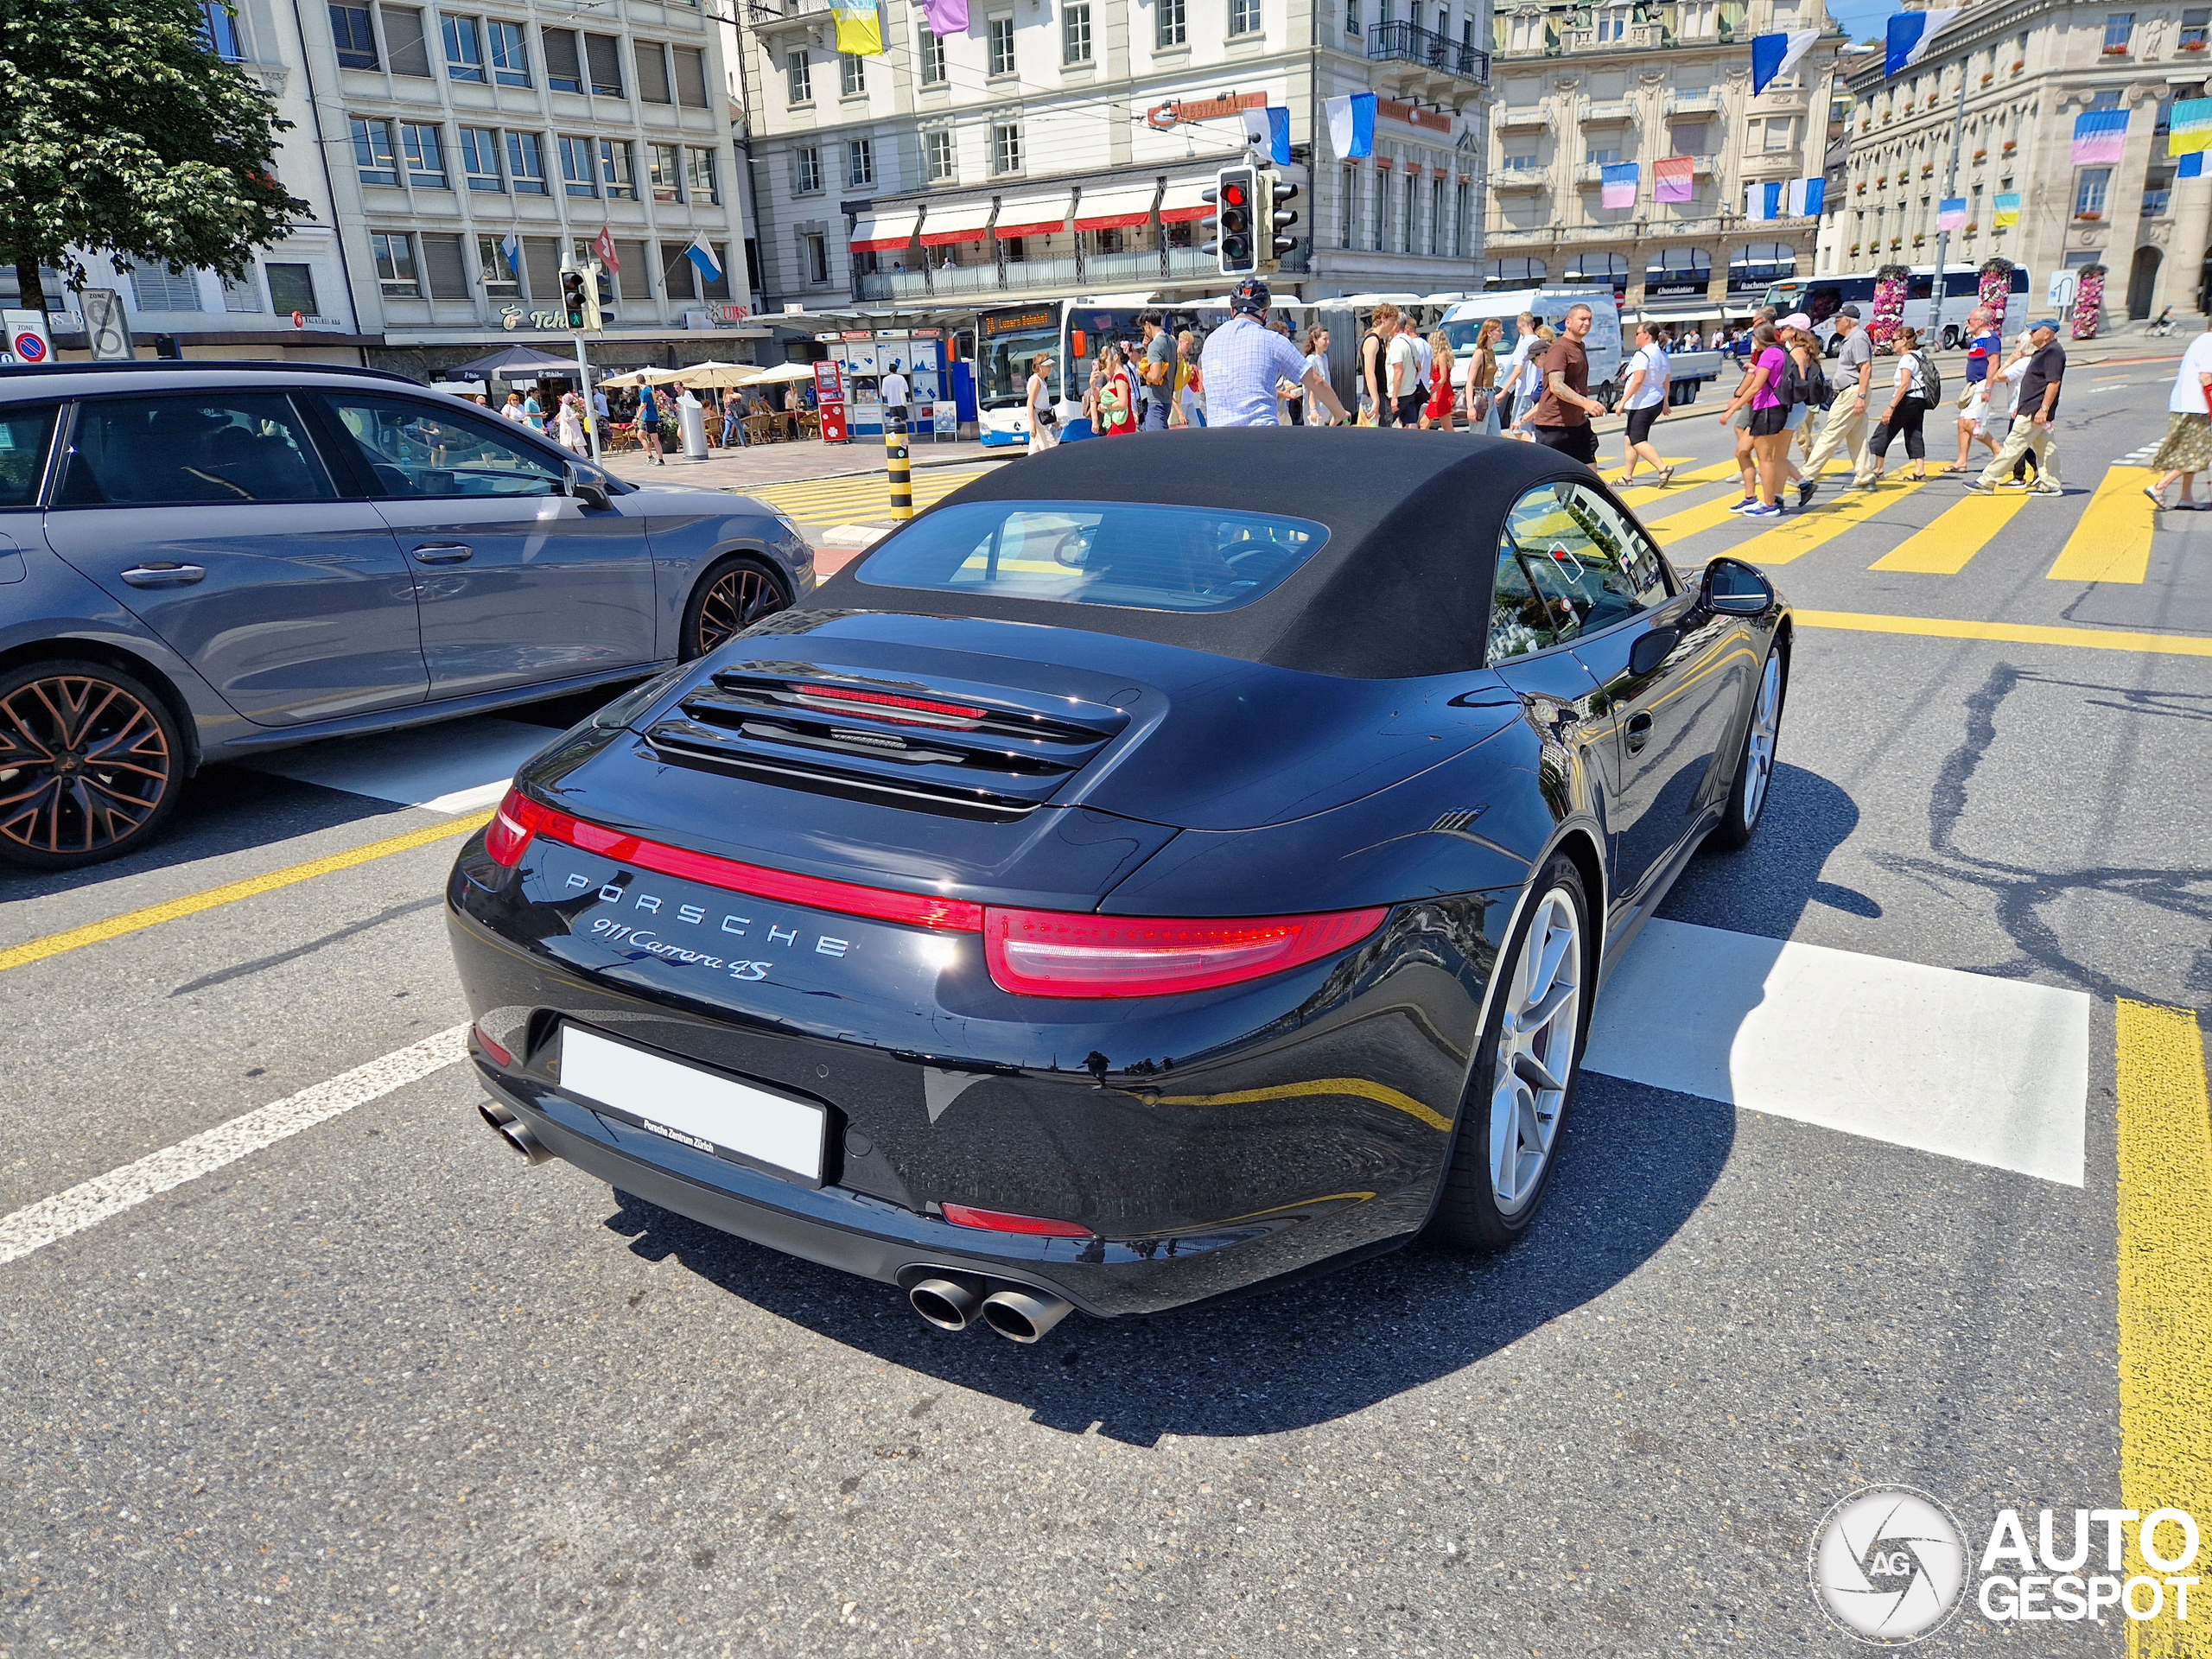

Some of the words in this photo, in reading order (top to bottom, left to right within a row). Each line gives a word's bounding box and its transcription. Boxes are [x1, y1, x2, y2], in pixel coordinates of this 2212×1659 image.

[1183, 96, 1255, 118] RESTAURANT
[1657, 285, 1695, 296] Chocolatier
[529, 310, 566, 329] Tch
[722, 305, 750, 321] UBS
[565, 872, 850, 958] PORSCHE
[590, 918, 633, 942] 911
[627, 930, 724, 969] Carrera
[727, 959, 774, 982] 4S
[643, 1119, 668, 1137] Porsche
[668, 1128, 694, 1147] Zentrum
[693, 1137, 714, 1154] Zürich
